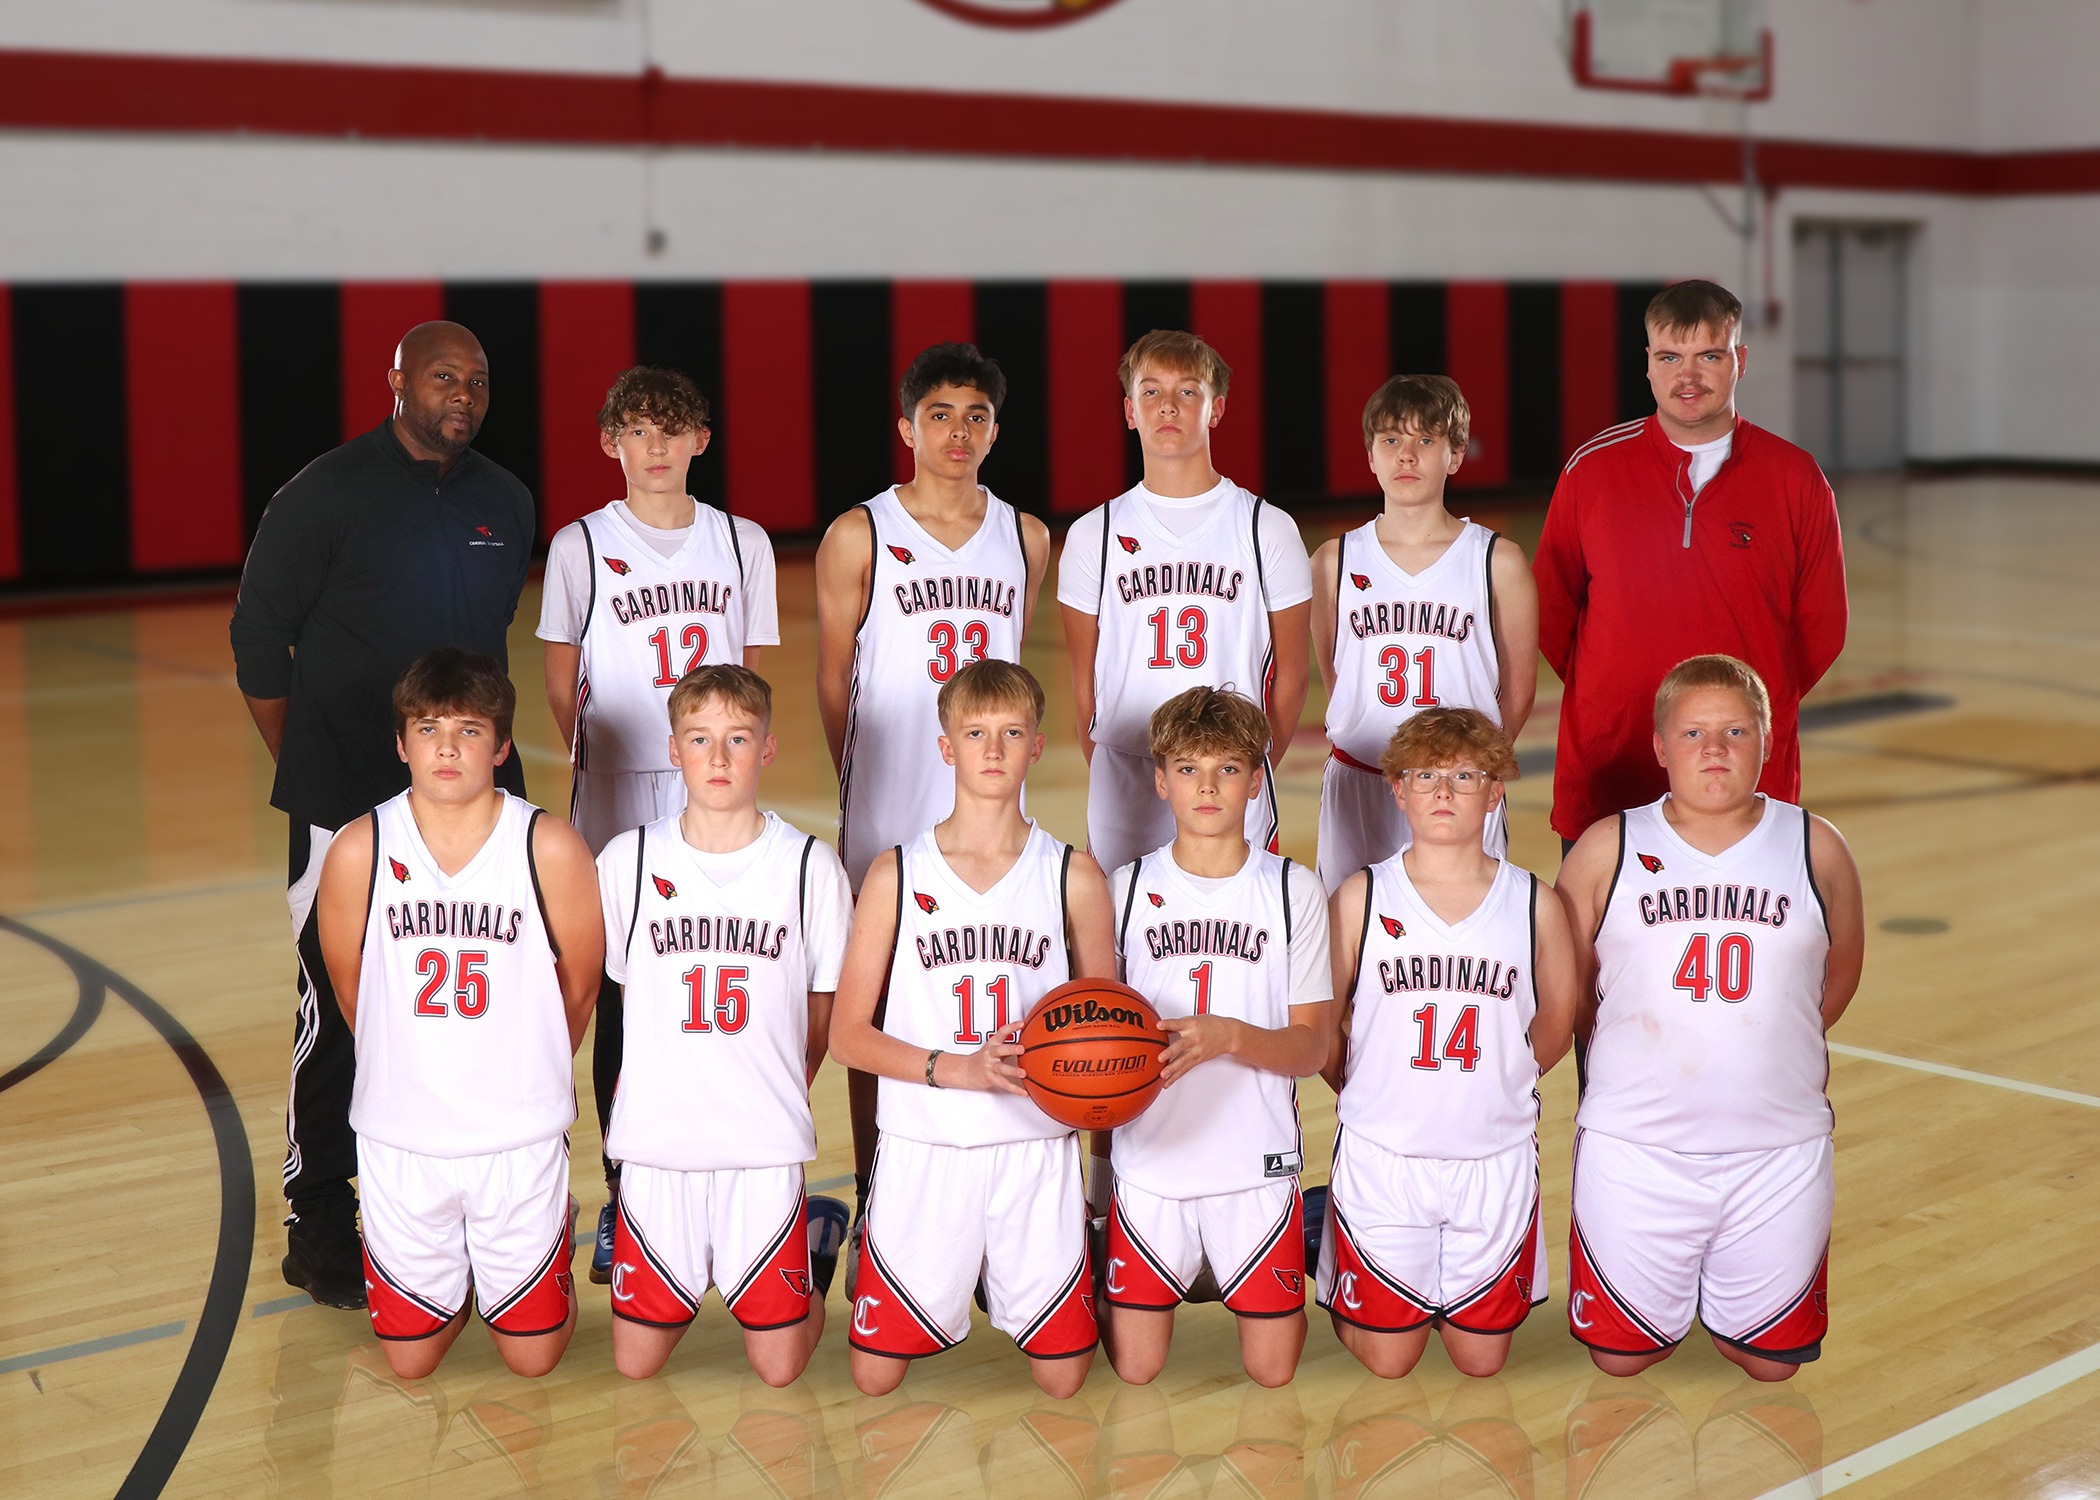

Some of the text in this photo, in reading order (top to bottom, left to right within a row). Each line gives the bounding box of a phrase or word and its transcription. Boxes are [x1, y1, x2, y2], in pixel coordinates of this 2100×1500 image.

[610, 579, 733, 626] CARDINALS
[894, 575, 1015, 618] CARDINALS
[1116, 561, 1245, 605] CARDINALS
[1147, 606, 1208, 669] 13
[1349, 601, 1475, 643] CARDINALS
[648, 622, 709, 688] 12
[927, 619, 990, 684] 33
[1377, 643, 1441, 708] 31
[386, 900, 524, 945] CARDINALS
[1640, 884, 1792, 928] CARDINALS
[649, 916, 788, 961] CARDINALS
[915, 924, 1051, 971] CARDINALS
[1143, 918, 1270, 964] CARDINALS
[414, 947, 490, 1019] 25
[1189, 960, 1213, 1015] 1
[1378, 954, 1519, 1001] CARDINALS
[1673, 932, 1754, 1003] 40
[681, 964, 750, 1035] 15
[952, 974, 1017, 1045] 11
[1042, 1000, 1144, 1032] Wilson
[1410, 1003, 1481, 1072] 14
[1051, 1054, 1148, 1073] EVOLUTION
